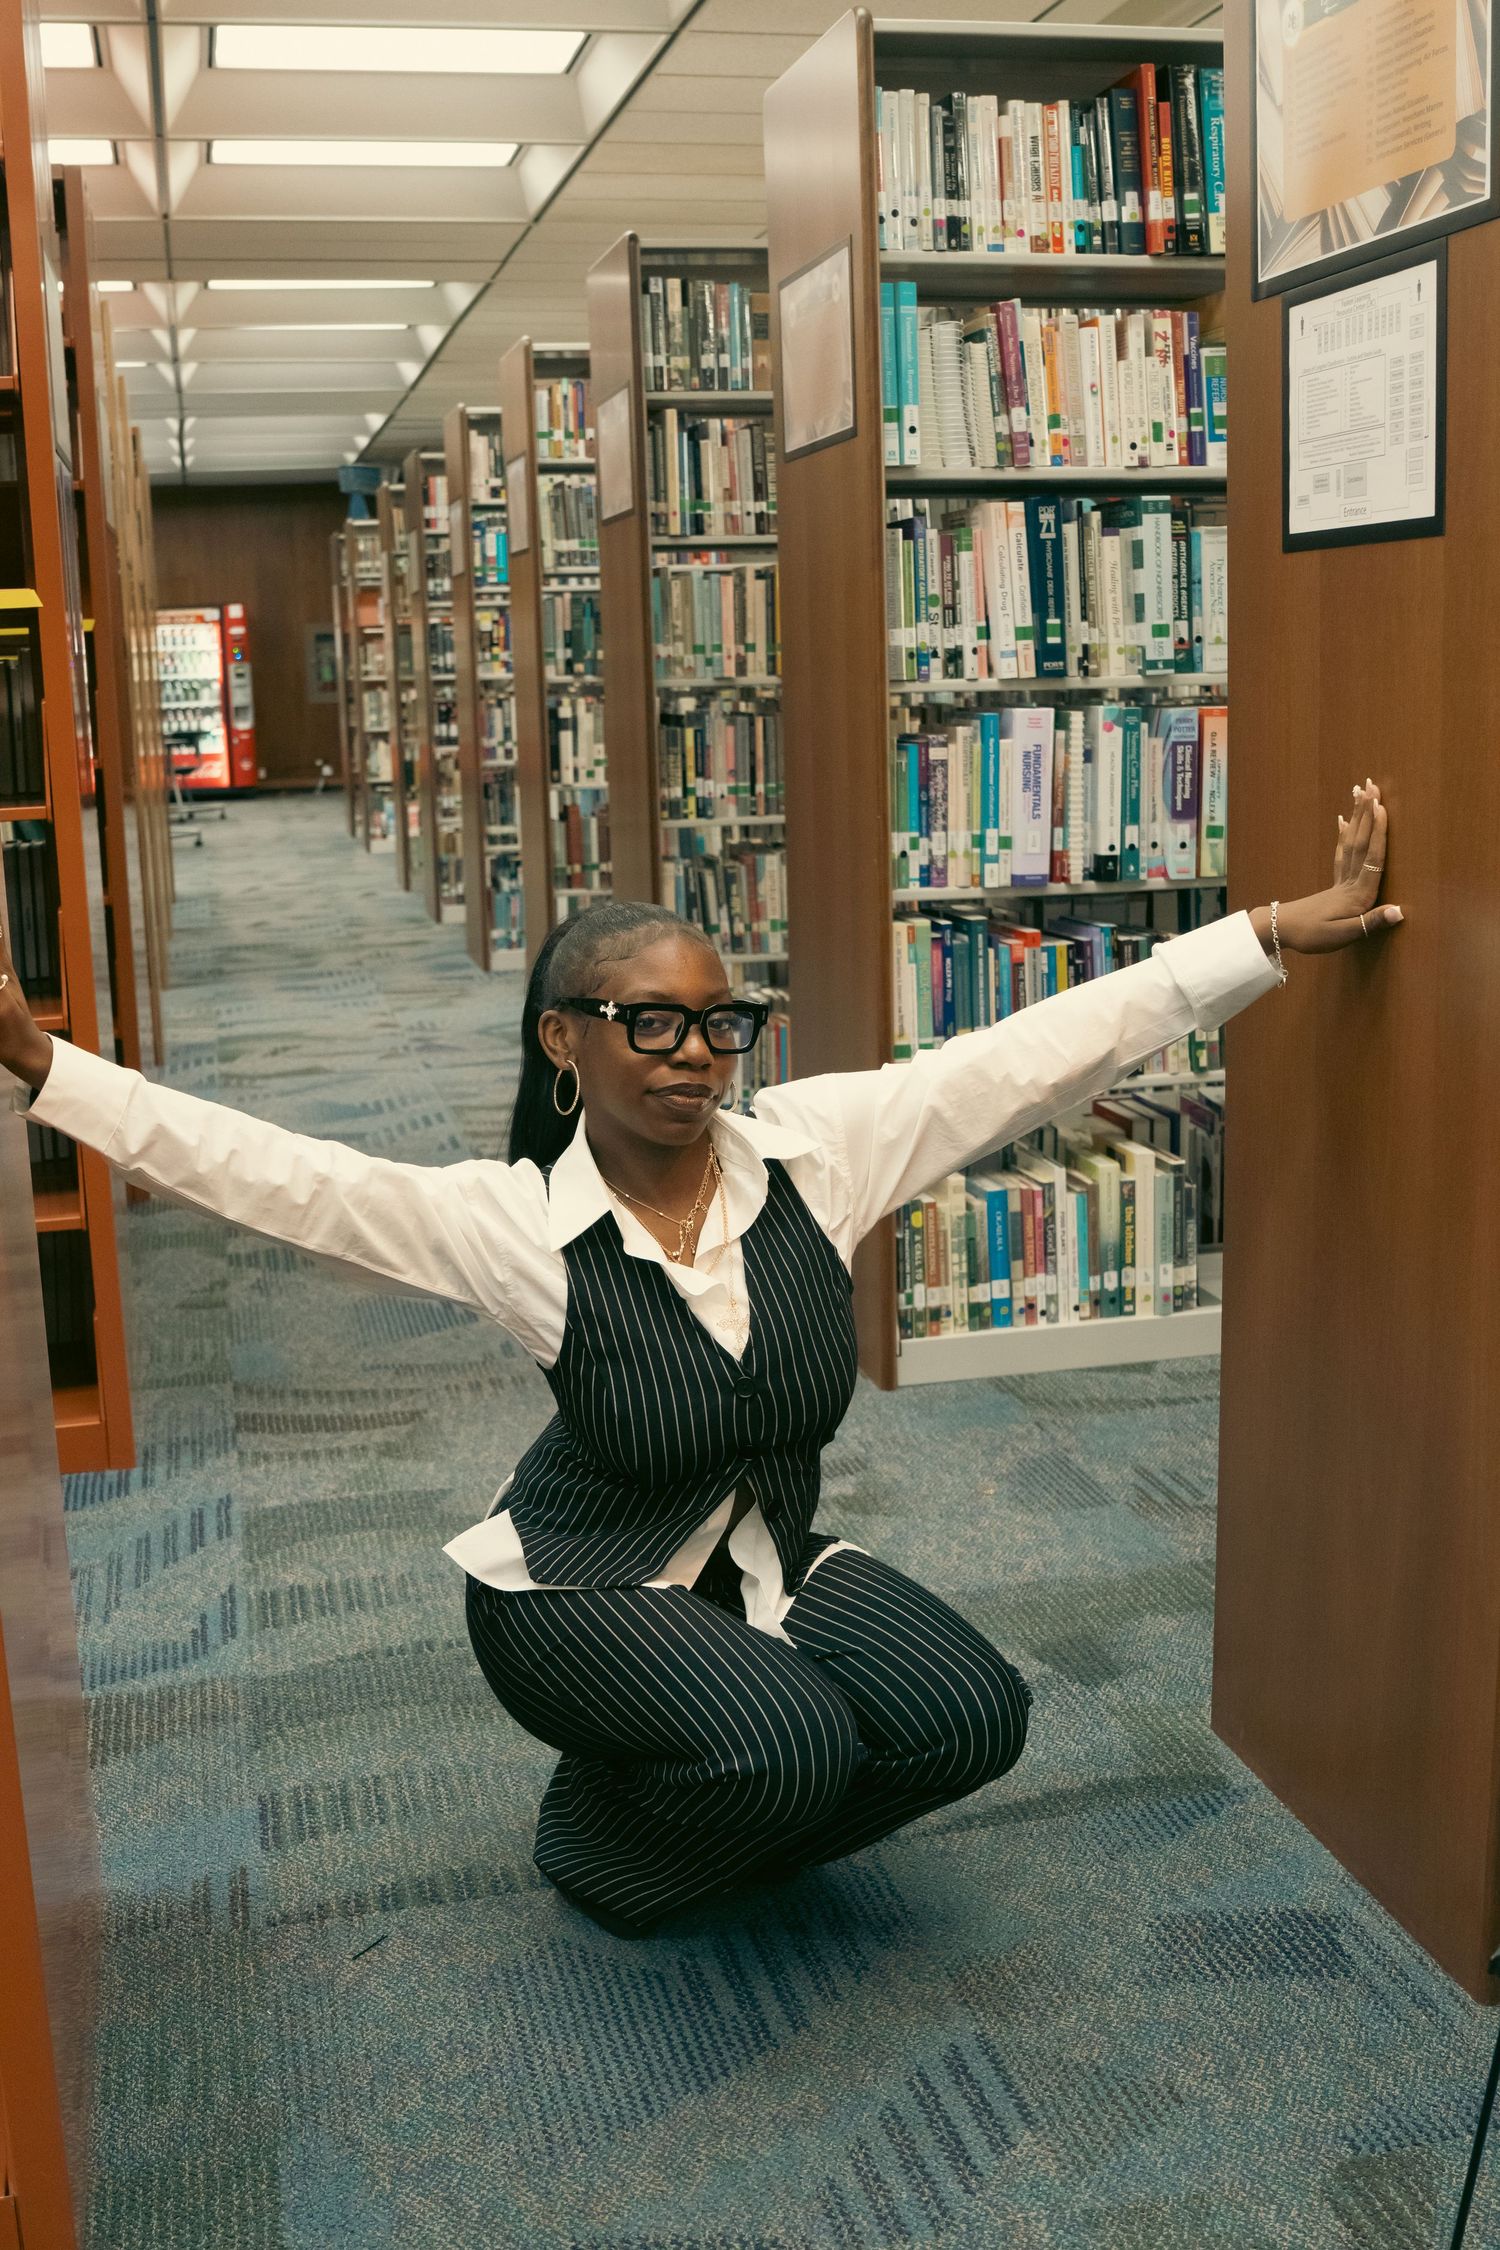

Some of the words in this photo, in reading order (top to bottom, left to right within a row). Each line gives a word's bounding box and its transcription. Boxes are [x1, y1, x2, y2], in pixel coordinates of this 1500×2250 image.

[1161, 137, 1172, 167] BOTOX
[1208, 117, 1224, 178] Respiratory
[1163, 170, 1173, 197] NATIO
[1189, 335, 1198, 370] Vaccines
[997, 544, 1007, 589] Calculating
[1015, 532, 1024, 571] Calculate
[1179, 540, 1188, 588] ANTICANCER
[1216, 558, 1225, 573] The
[1109, 560, 1119, 593] Healing
[1208, 561, 1217, 597] American
[1217, 574, 1225, 605] Advance
[998, 591, 1008, 611] Drug
[1112, 596, 1120, 615] with
[1155, 570, 1164, 620] NONPRESCRIPT
[1180, 589, 1189, 619] AGENTS
[1176, 744, 1184, 764] Skills
[1184, 744, 1193, 772] Clinical
[1209, 749, 1217, 778] REVIEW
[1022, 750, 1032, 793] NURSING
[1031, 744, 1041, 820] FUNDAMENTALS
[1183, 772, 1193, 799] Nursing
[1174, 773, 1184, 811] Techniques
[1124, 1205, 1134, 1223] the
[1045, 1223, 1055, 1253] Good
[1125, 1225, 1135, 1264] kitchen
